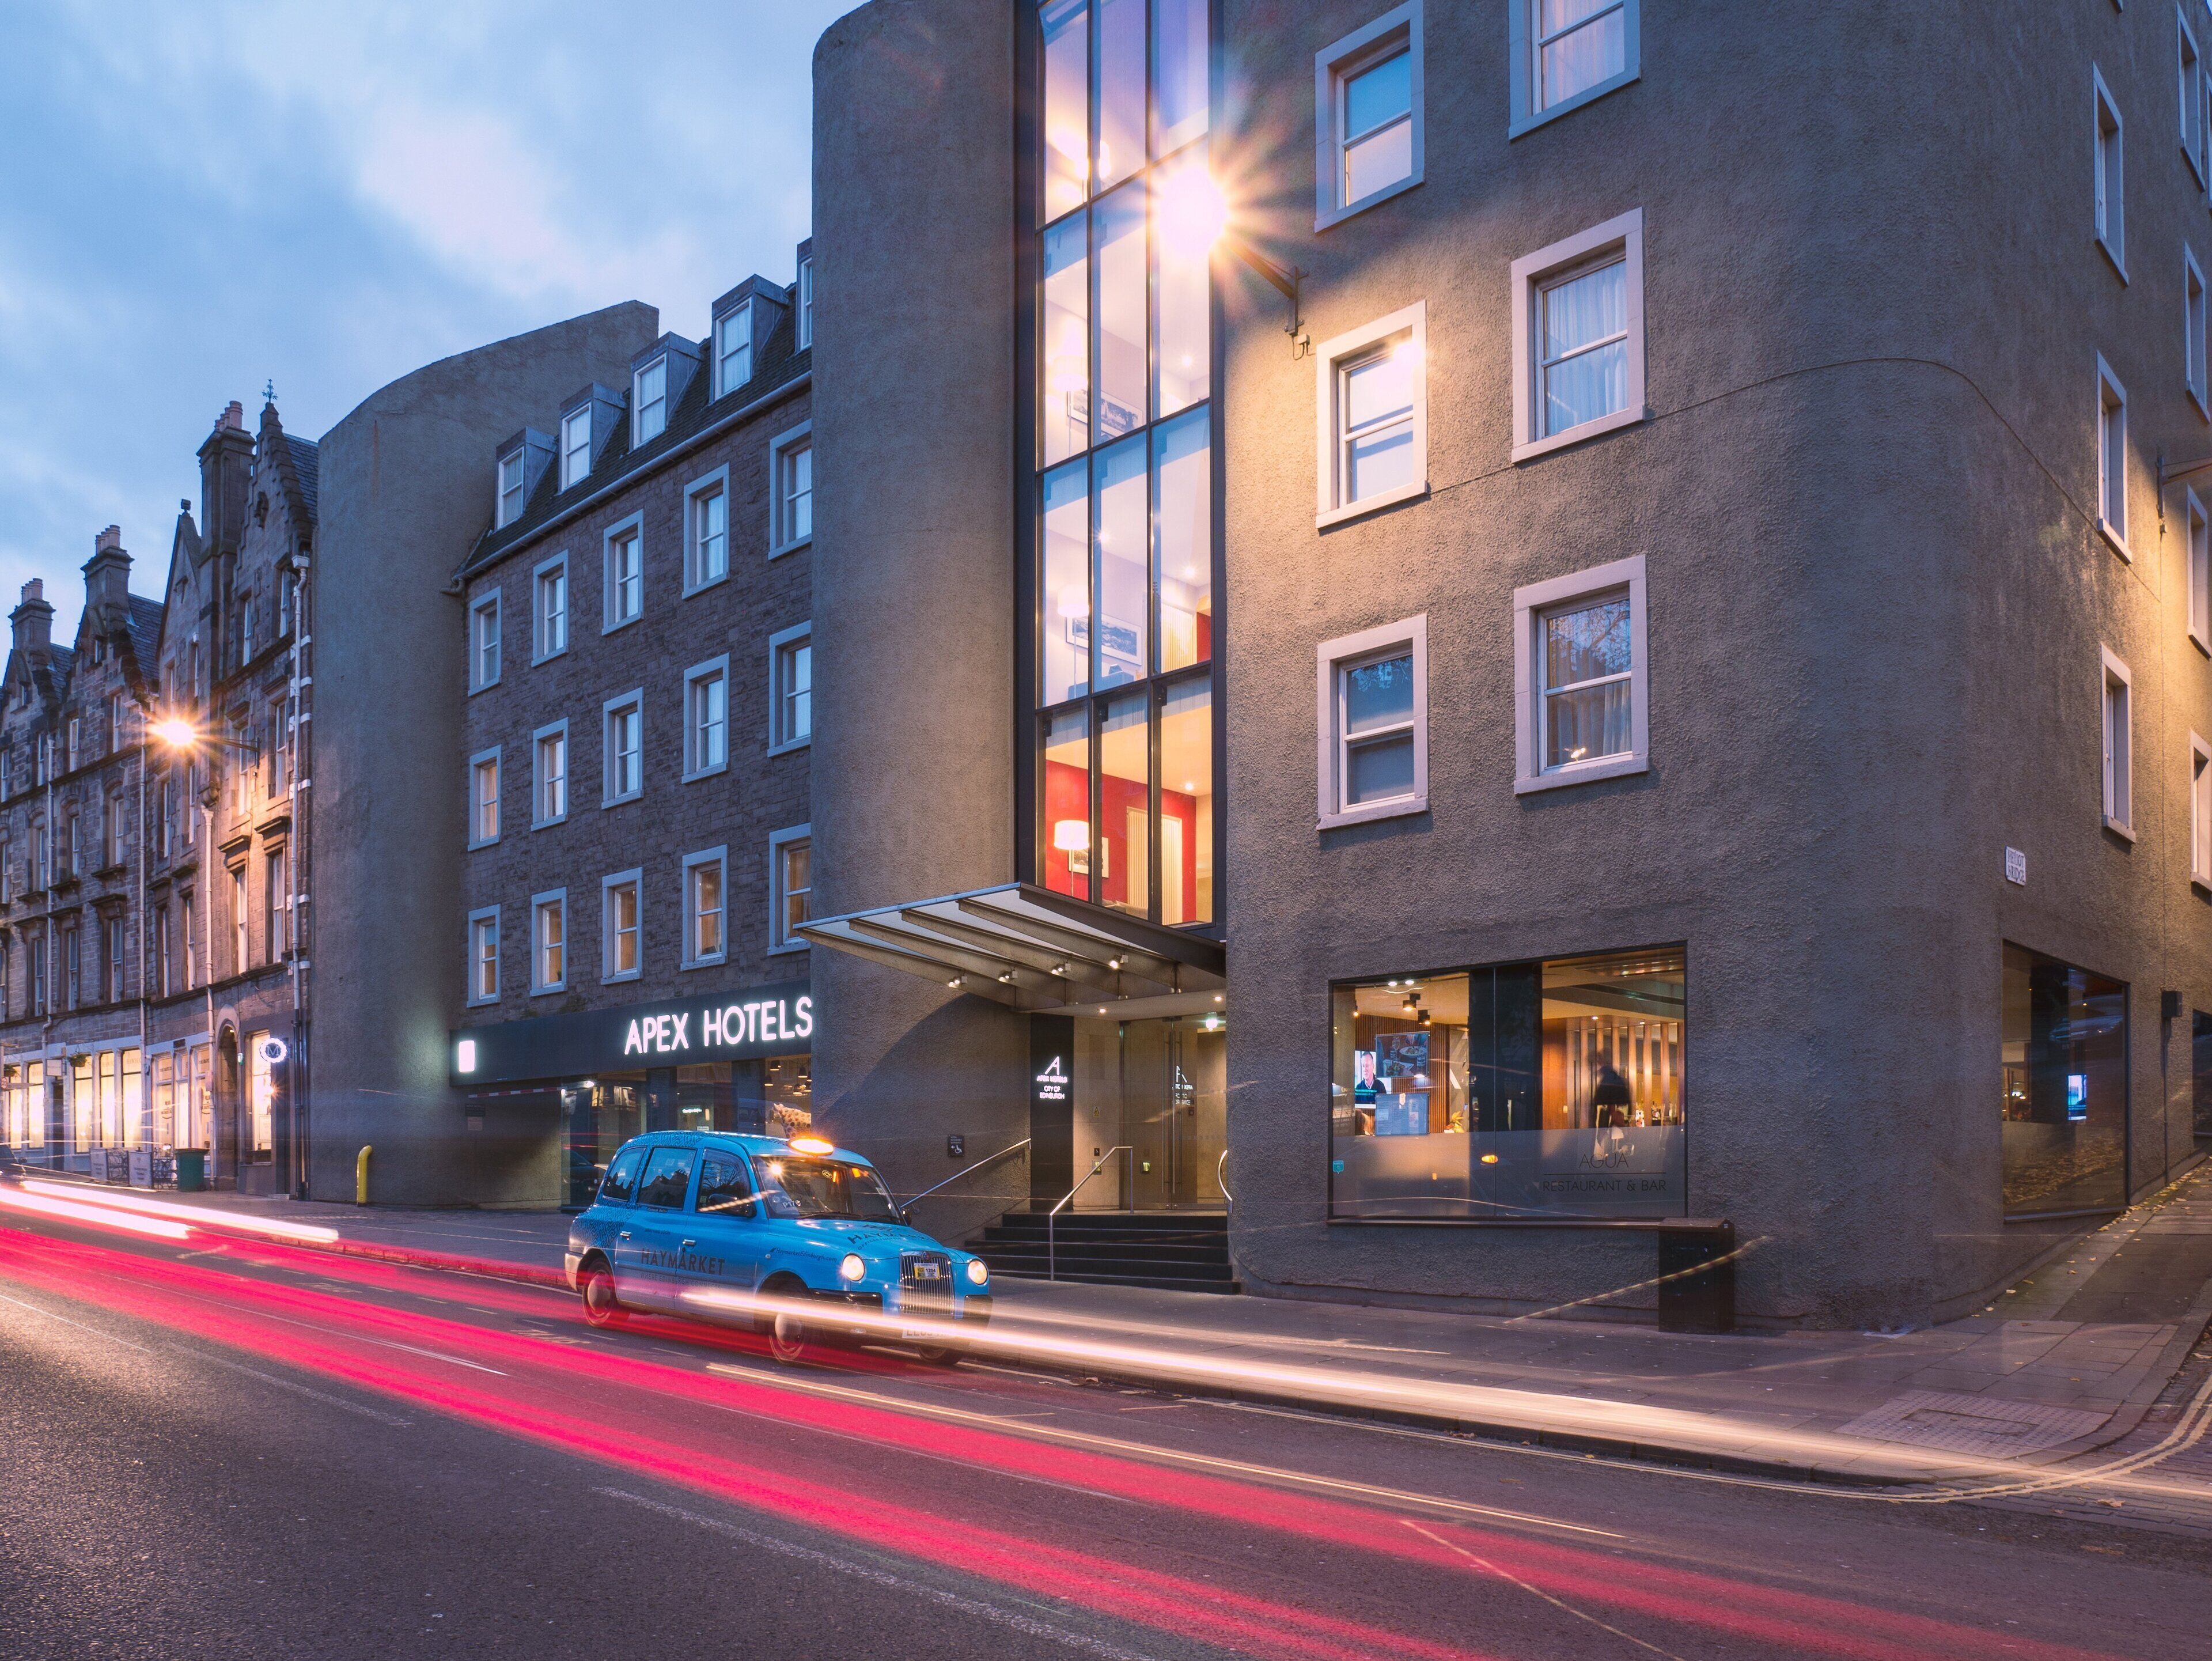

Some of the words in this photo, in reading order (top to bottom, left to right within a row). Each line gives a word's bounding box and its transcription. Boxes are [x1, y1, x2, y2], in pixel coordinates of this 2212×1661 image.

[624, 1012, 689, 1055] APEX
[703, 996, 813, 1047] HOTELS
[267, 1045, 281, 1056] M
[1044, 1055, 1060, 1076] A
[1579, 1153, 1629, 1168] AGUA
[1543, 1181, 1620, 1192] RESTAURANT
[1627, 1180, 1636, 1191] &
[1642, 1179, 1666, 1191] BAR
[641, 1247, 725, 1276] HAYMARKET
[776, 1248, 838, 1262] HaymarketEdinburgh.com
